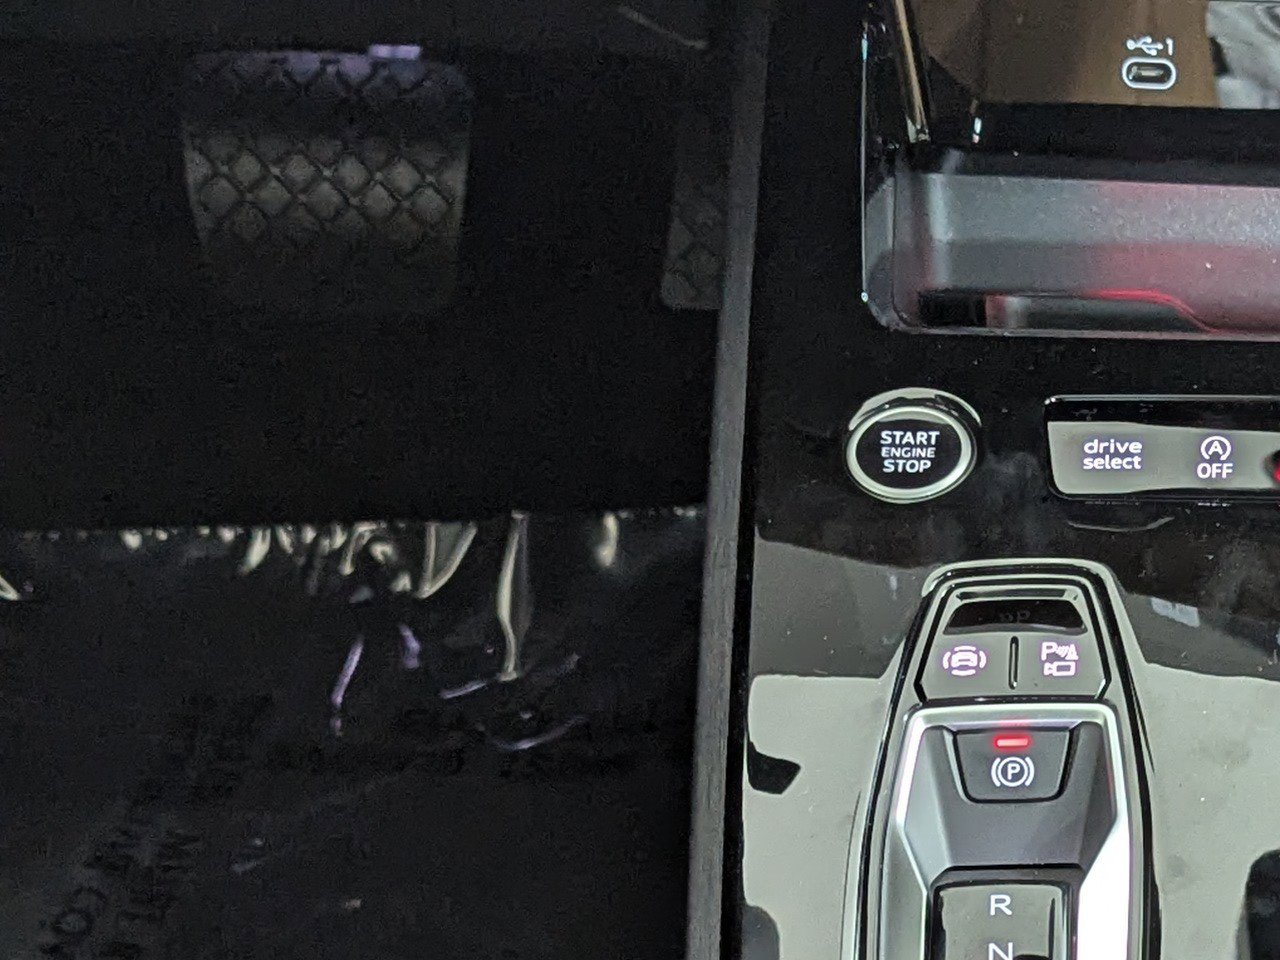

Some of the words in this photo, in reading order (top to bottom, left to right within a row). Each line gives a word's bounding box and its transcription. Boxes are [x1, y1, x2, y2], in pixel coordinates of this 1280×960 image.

[1165, 37, 1175, 56] 1
[880, 430, 940, 445] START
[880, 446, 937, 458] ENGINE
[1083, 438, 1143, 454] drive
[882, 459, 932, 473] STOP
[1082, 455, 1142, 470] select
[1196, 462, 1233, 479] OFF
[989, 894, 1013, 916] R
